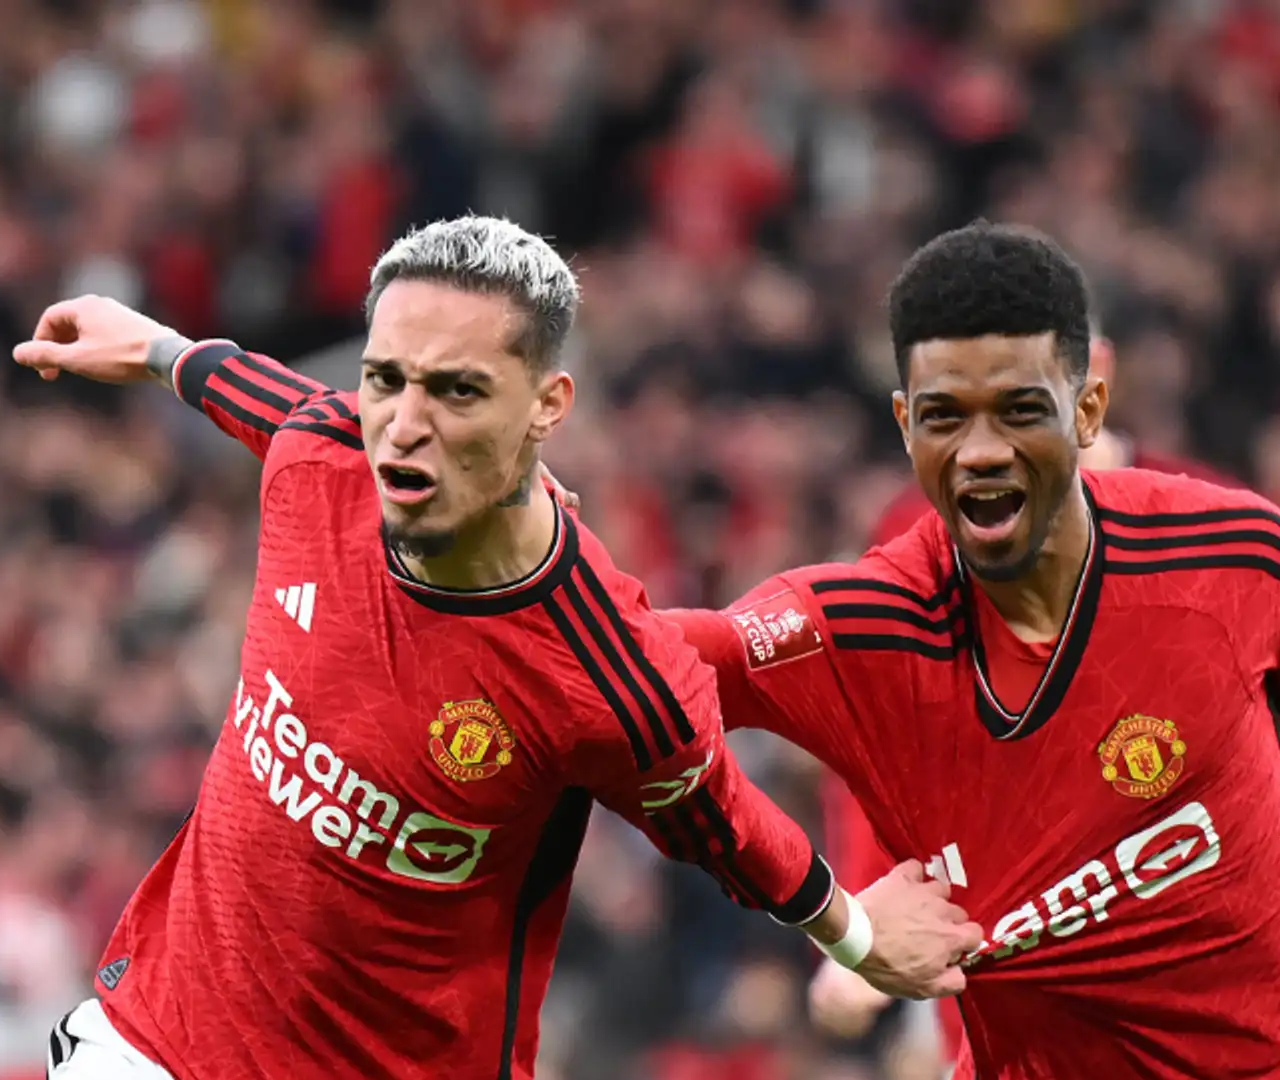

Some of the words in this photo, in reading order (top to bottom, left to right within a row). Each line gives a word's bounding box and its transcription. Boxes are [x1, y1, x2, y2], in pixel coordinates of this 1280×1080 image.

[747, 628, 766, 661] CUP
[234, 674, 385, 859] viewer
[264, 668, 400, 829] Team
